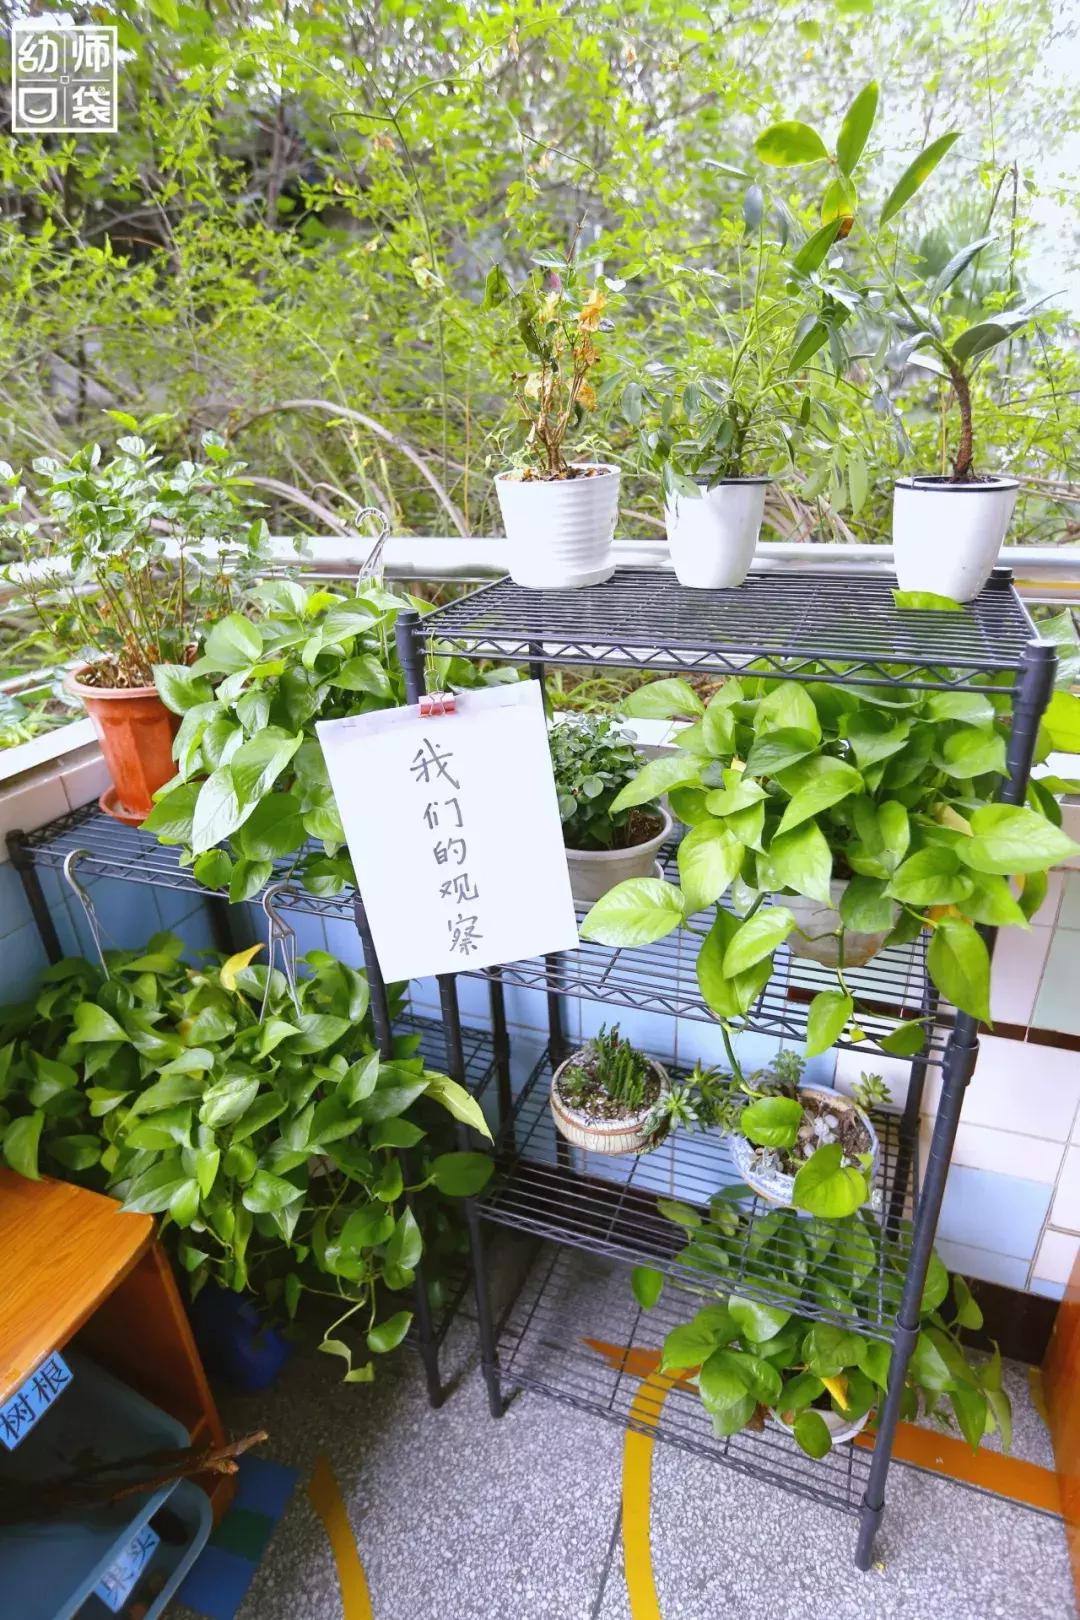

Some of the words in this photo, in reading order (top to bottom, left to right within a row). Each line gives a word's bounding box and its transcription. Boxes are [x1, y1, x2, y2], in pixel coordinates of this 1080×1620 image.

[410, 738, 483, 955] 我们的观察
[0, 1358, 70, 1441] 树根
